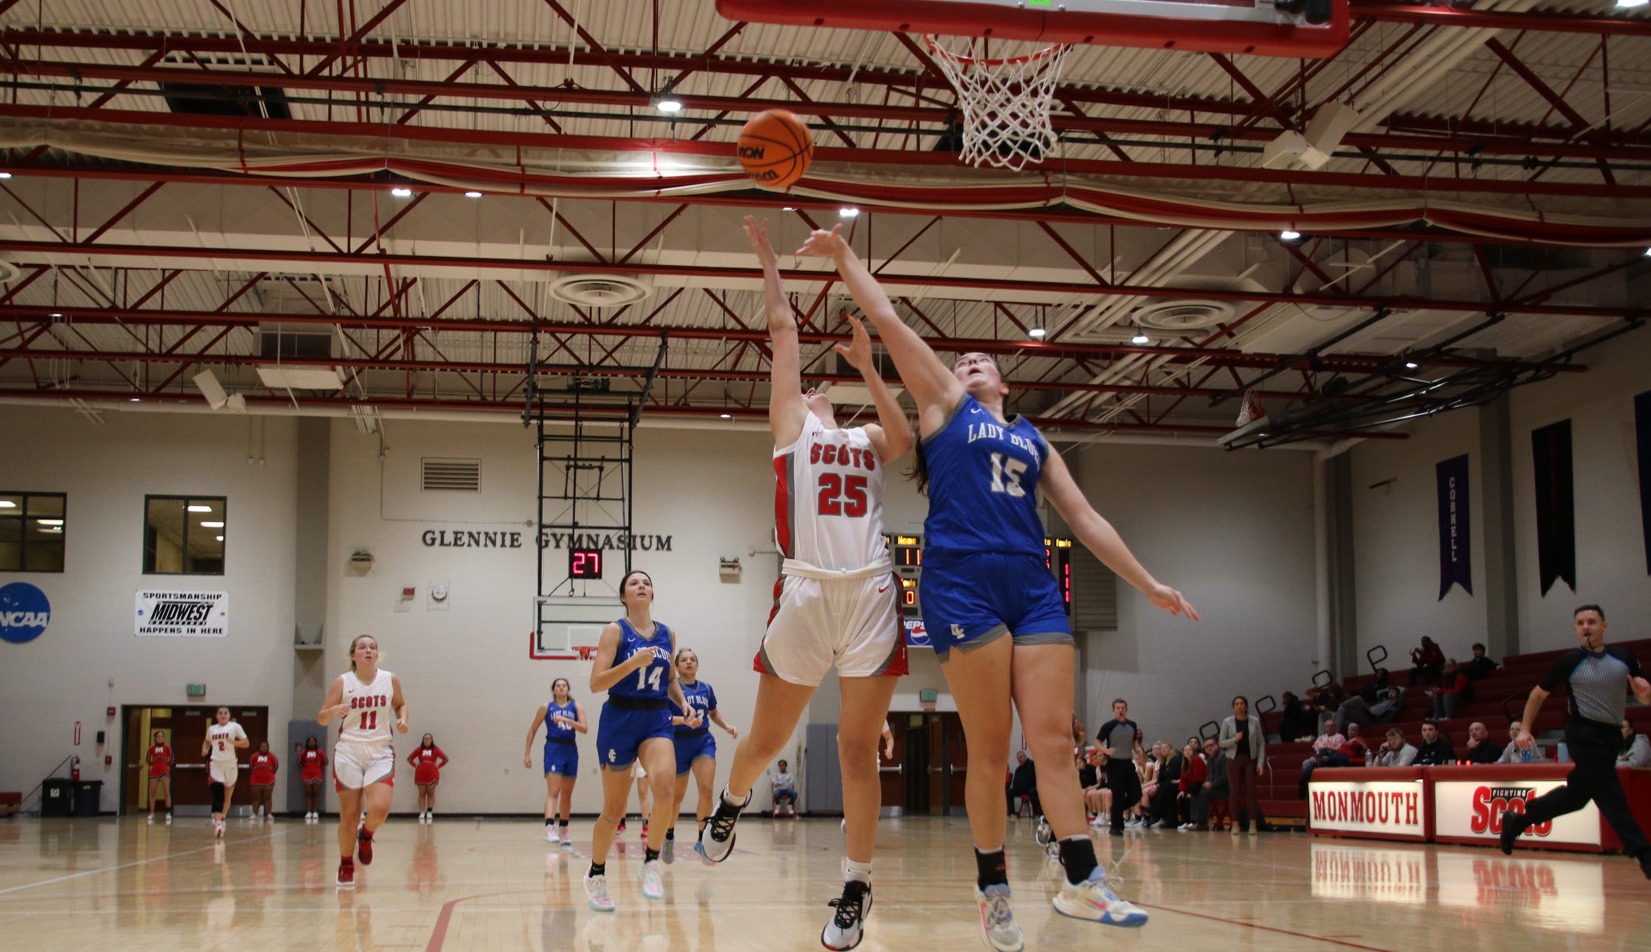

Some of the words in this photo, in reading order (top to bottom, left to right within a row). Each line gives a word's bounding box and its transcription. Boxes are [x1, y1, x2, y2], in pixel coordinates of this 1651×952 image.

[967, 422, 1003, 444] LADY
[810, 442, 875, 471] SCOTS
[991, 452, 1028, 498] 15
[818, 472, 867, 517] 25
[1449, 477, 1458, 563] CORNELL
[422, 530, 522, 547] GLENNIE
[536, 532, 673, 551] GYMNASIUM
[573, 553, 599, 574] 27
[143, 592, 222, 600] SPORTSMANSHIP
[150, 603, 214, 621] MIDWEST
[637, 666, 664, 691] 14
[351, 695, 387, 709] SCOTS
[360, 710, 377, 730] 11
[218, 741, 225, 751] 2
[1313, 791, 1419, 825] MONMOUTH
